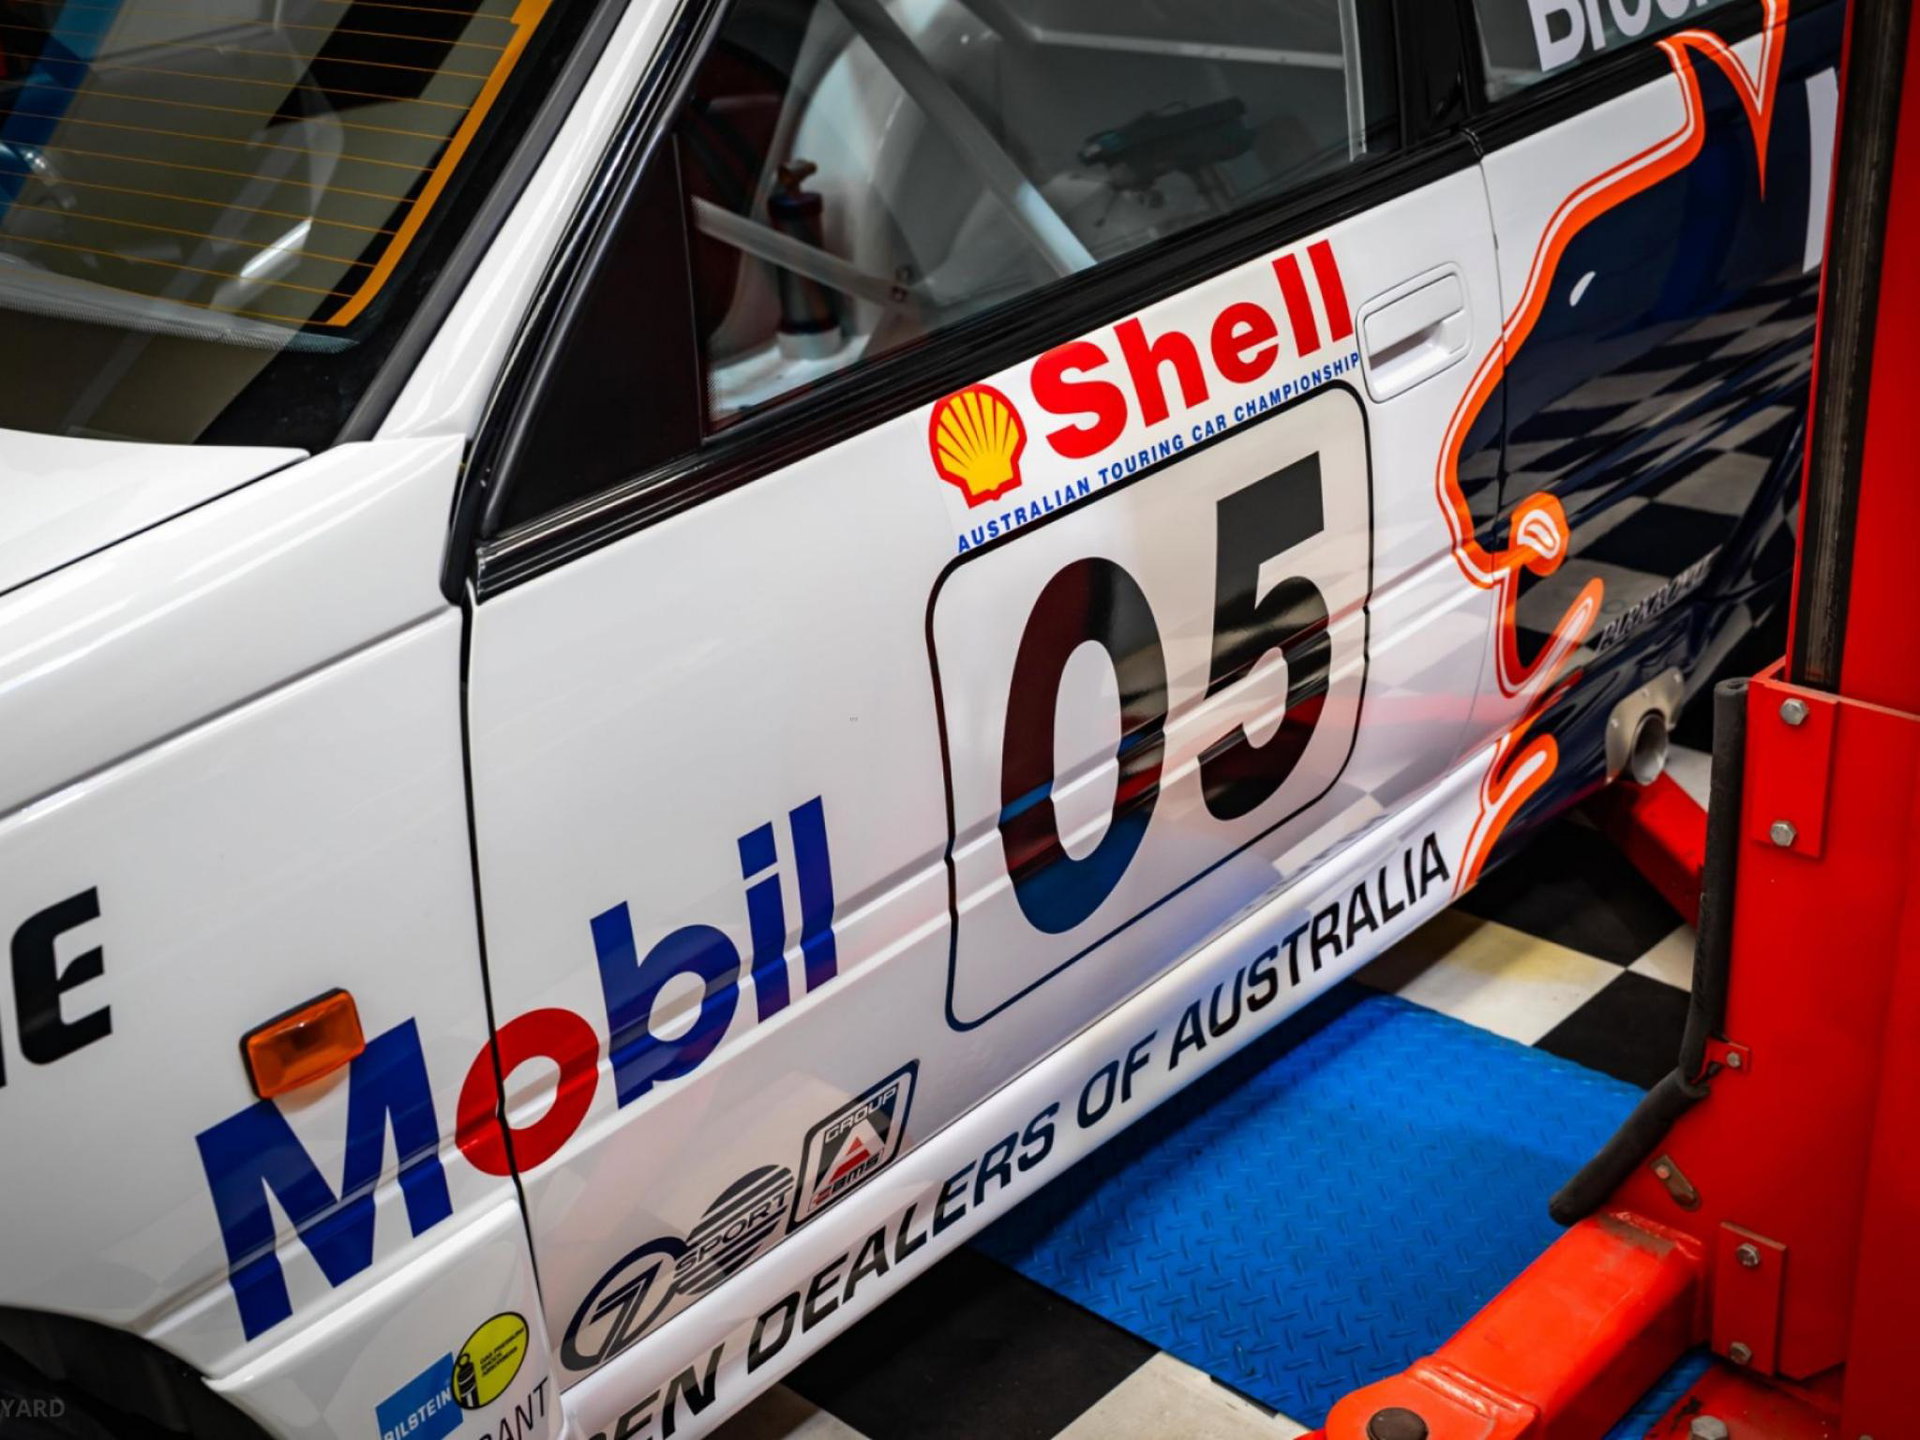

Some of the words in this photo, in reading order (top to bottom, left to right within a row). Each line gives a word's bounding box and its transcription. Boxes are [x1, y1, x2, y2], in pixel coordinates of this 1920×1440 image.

[957, 477, 1091, 553] AUSTRALIAN
[1098, 434, 1185, 485] TOURING
[1191, 413, 1228, 443] CAR
[1233, 351, 1361, 423] CHAMPIONSHIP
[1030, 239, 1354, 460] Shell
[999, 450, 1333, 936] 05
[194, 795, 838, 1343] Mobil
[588, 1342, 726, 1440] EN
[747, 1101, 1061, 1375] DEALERS
[1076, 1029, 1158, 1130] OF
[1168, 831, 1450, 1072] AUSTRALIA
[824, 1086, 897, 1144] GROUP
[674, 1185, 793, 1274] SPORT
[478, 1376, 549, 1440] ANT
